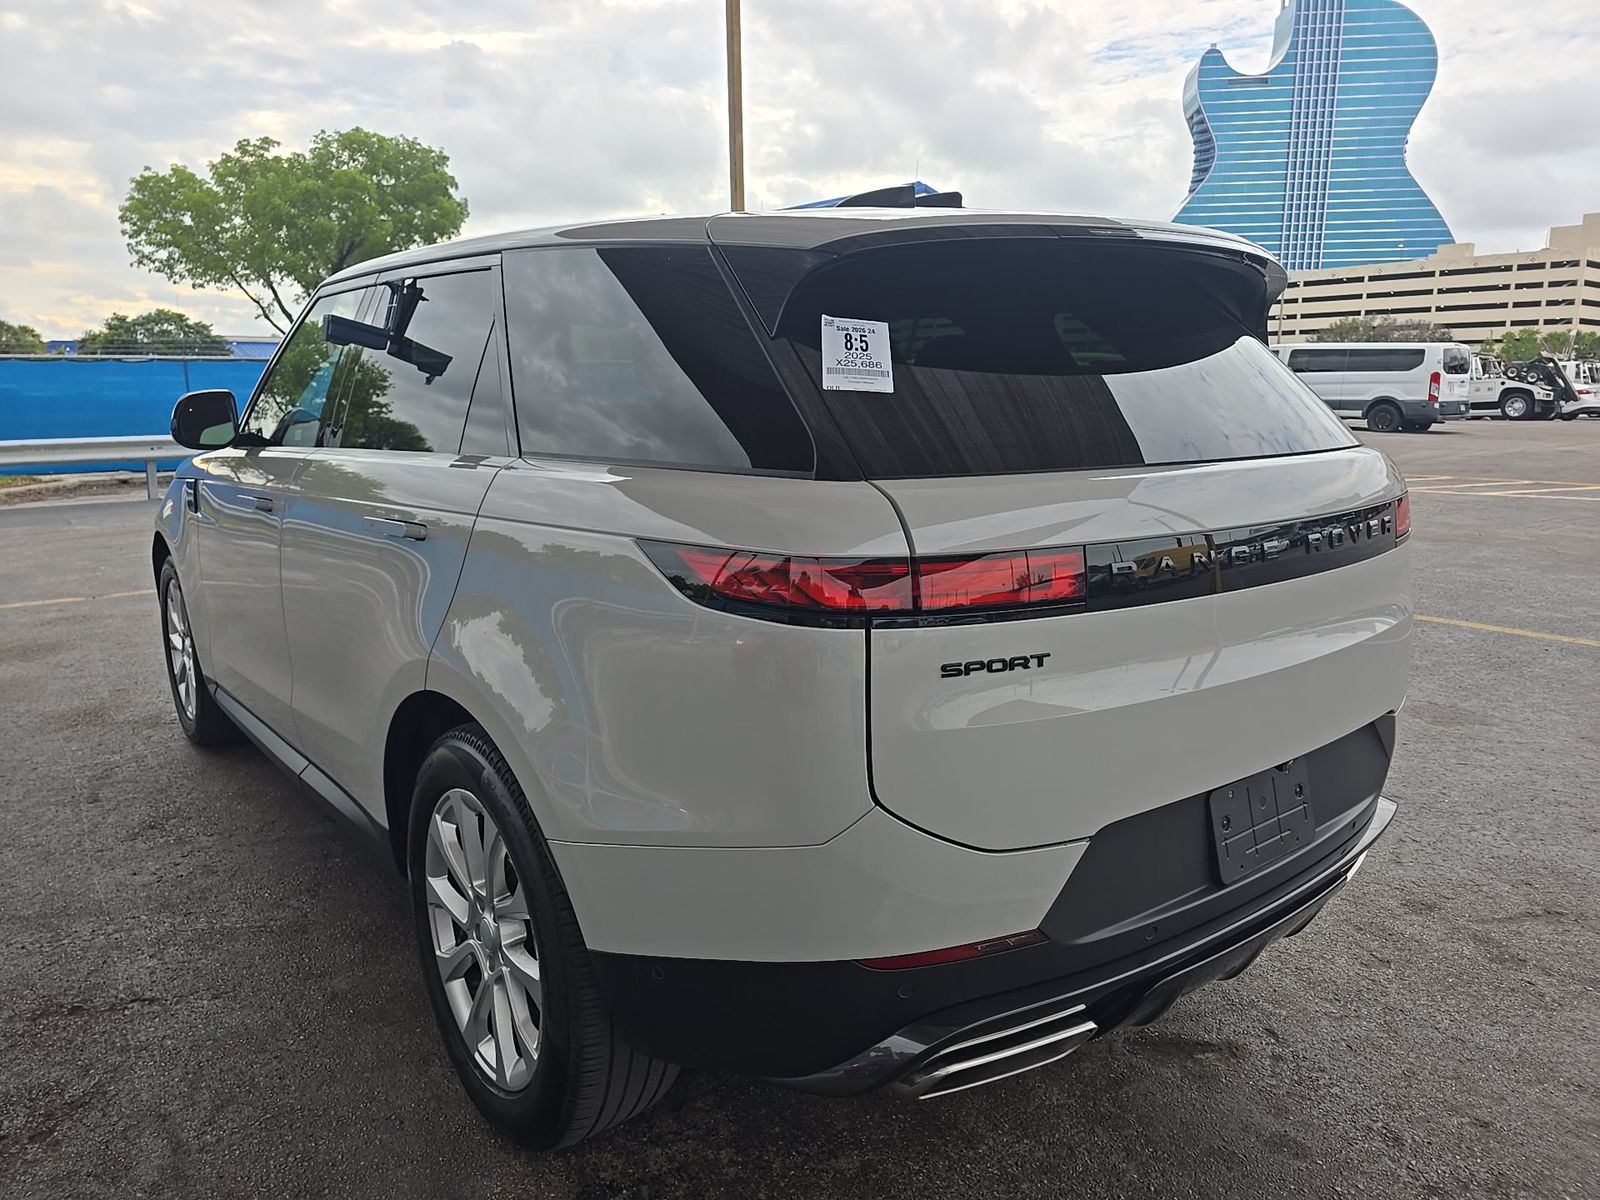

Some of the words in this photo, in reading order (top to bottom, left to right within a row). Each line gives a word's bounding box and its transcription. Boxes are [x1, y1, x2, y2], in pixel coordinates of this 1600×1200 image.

[844, 351, 872, 361] 2025
[1109, 540, 1280, 578] RANGE
[1305, 515, 1392, 554] ROVER
[940, 652, 1051, 678] SPORT
